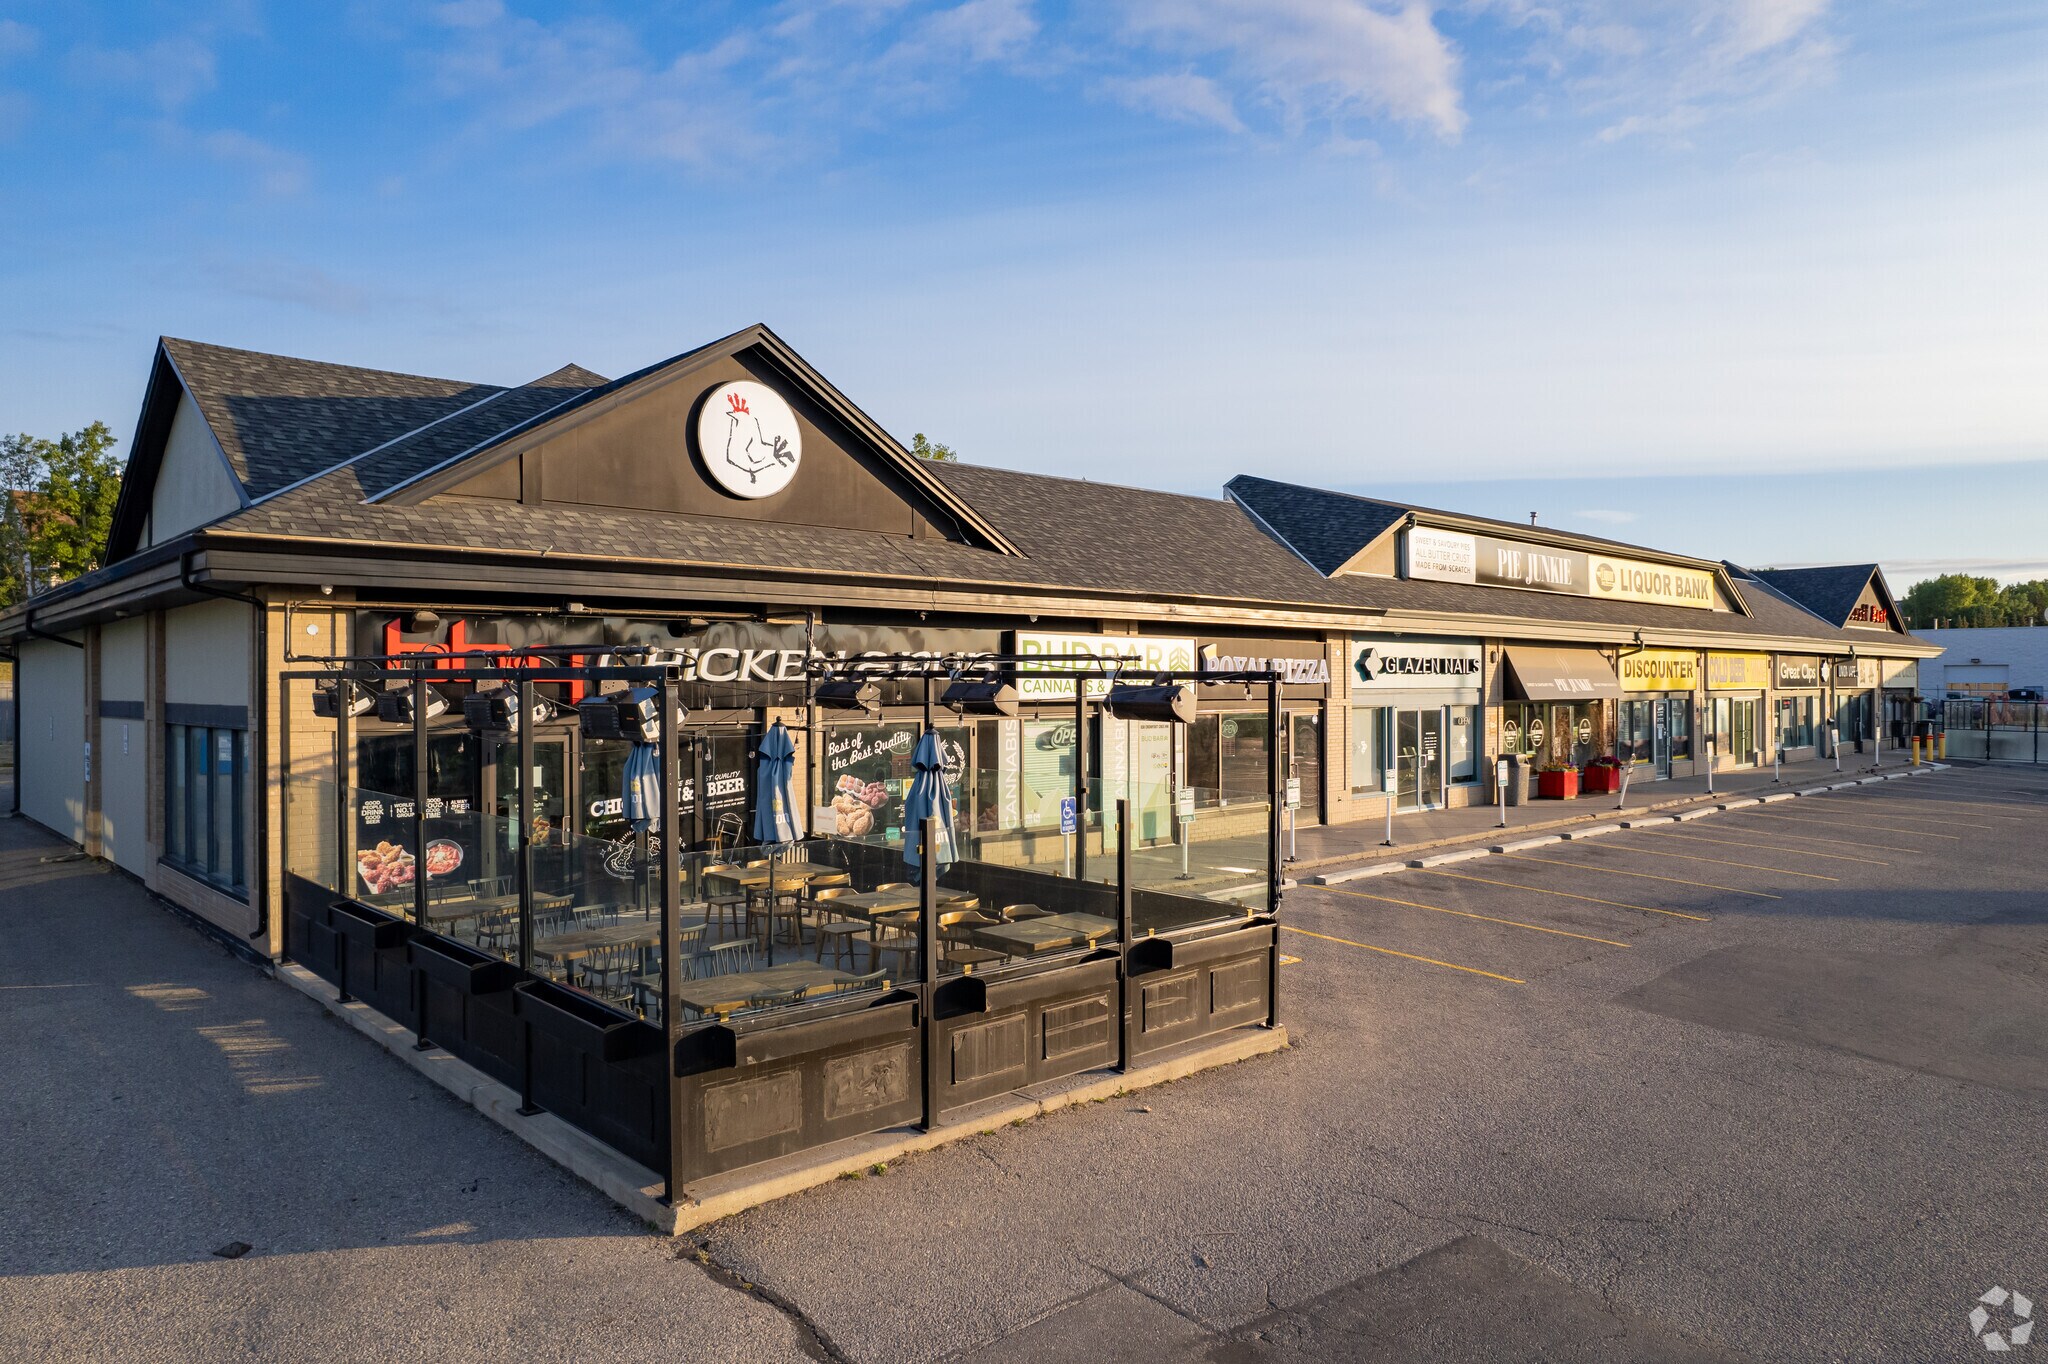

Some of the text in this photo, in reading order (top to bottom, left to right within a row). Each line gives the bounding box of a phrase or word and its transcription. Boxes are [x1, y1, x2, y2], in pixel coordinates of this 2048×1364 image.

[1415, 547, 1470, 564] ALL BUTTER CRUST
[1415, 561, 1471, 574] MADE FROM SCRATCH
[1497, 548, 1573, 585] PIE JUNKIE
[1620, 568, 1709, 600] LIQUOR BANK
[1022, 640, 1163, 672] BUD BAR
[1385, 656, 1480, 674] GLAZEN NAILS
[1206, 655, 1331, 684] ROYAL PIZZA
[1624, 659, 1694, 679] DISCOUNTER
[1709, 656, 1728, 683] COLD
[1729, 657, 1746, 683] BEER
[1780, 662, 1801, 680] Great
[1023, 679, 1094, 693] CANNAS
[1097, 679, 1105, 693] &
[828, 732, 863, 756] Best of
[1053, 727, 1076, 744] OPE
[831, 756, 849, 771] the
[850, 746, 873, 765] Best
[874, 731, 911, 754] Quality
[1115, 721, 1125, 799] ANNABI
[714, 770, 741, 781] QUALITY
[1005, 719, 1017, 829] CANNABIS
[706, 777, 745, 797] BEER
[361, 809, 384, 817] DRINK
